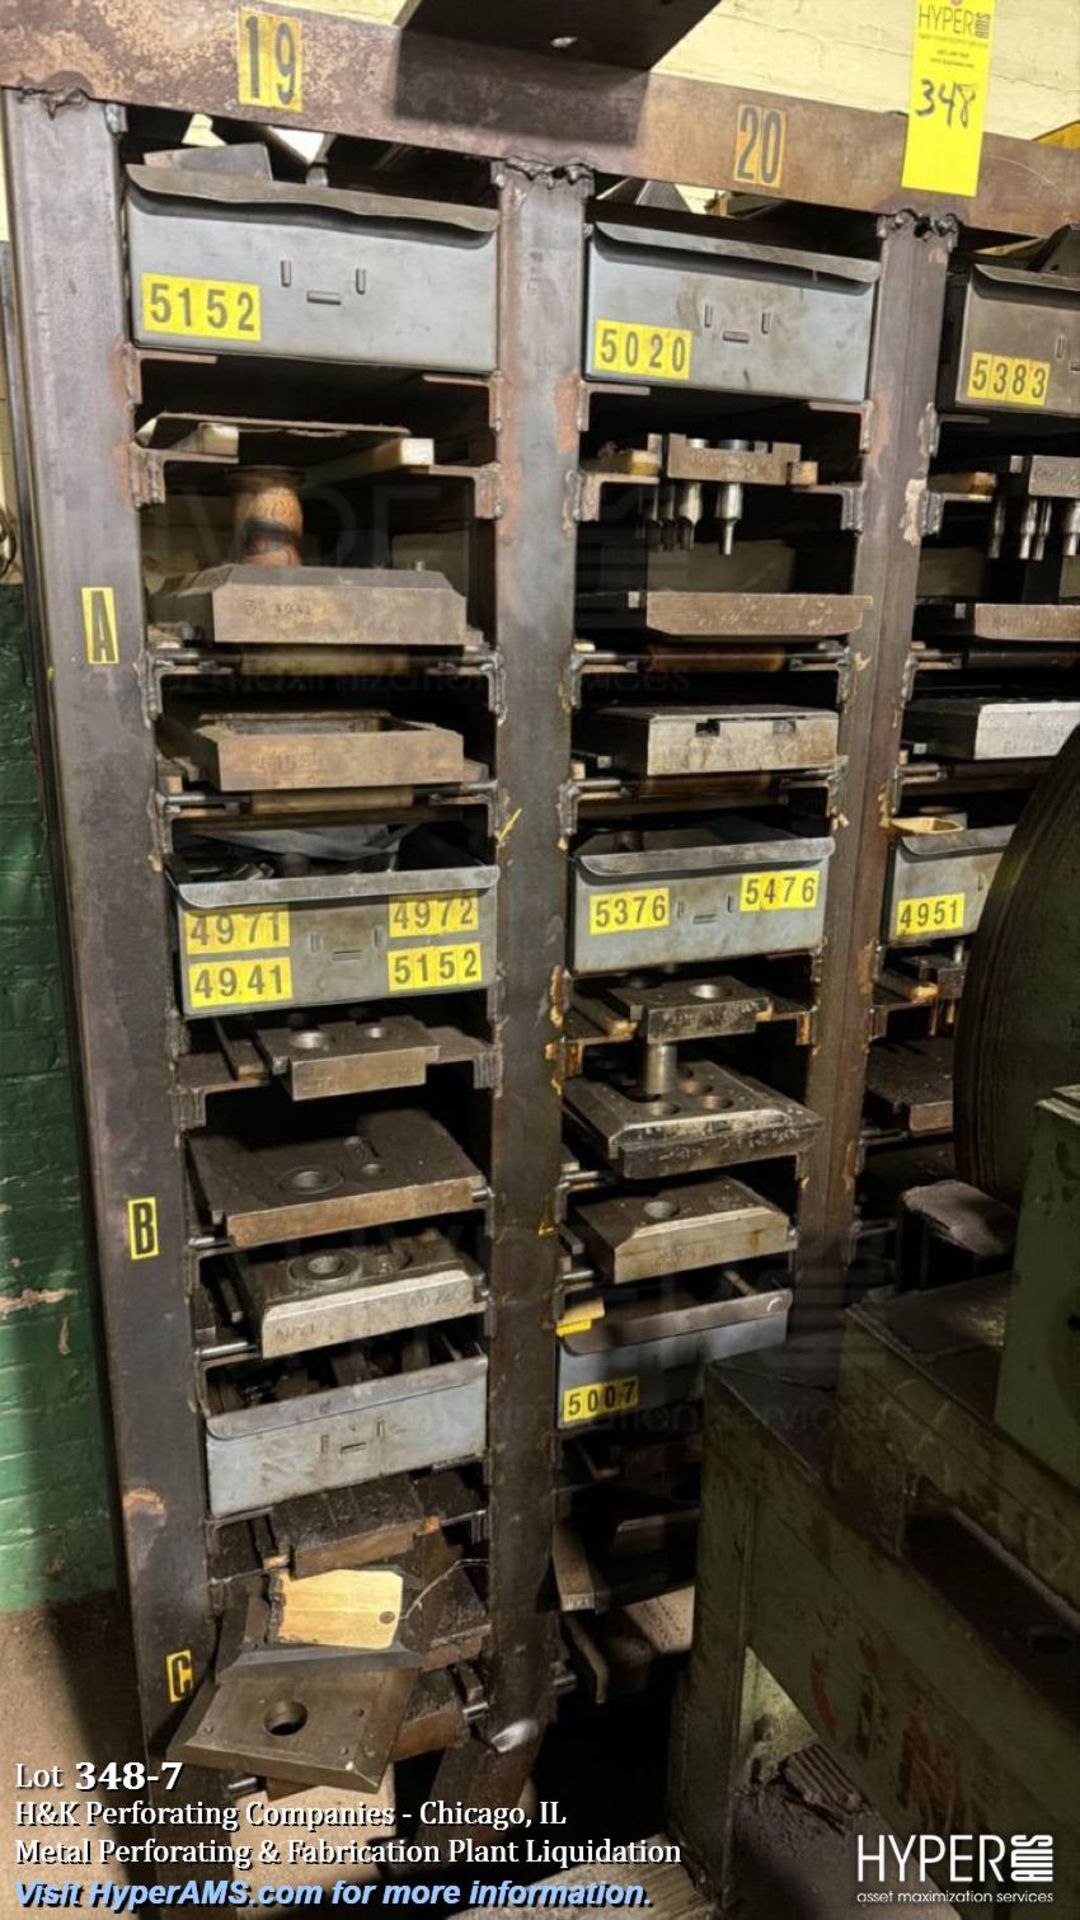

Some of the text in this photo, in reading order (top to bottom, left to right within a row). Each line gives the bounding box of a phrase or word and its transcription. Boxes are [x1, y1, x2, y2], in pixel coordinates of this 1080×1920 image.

[919, 4, 973, 34] HYPER
[245, 15, 297, 104] 19
[915, 79, 977, 128] 348
[737, 109, 785, 184] 20
[150, 284, 256, 332] 5152
[600, 328, 686, 371] 5020
[971, 353, 1047, 400] 5383
[89, 589, 117, 663] A
[745, 876, 818, 904] 5476
[190, 909, 281, 946] 4971
[394, 900, 475, 929] 4972
[595, 895, 667, 928] 5376
[899, 899, 960, 929] 4951
[195, 964, 283, 999] 4941
[395, 949, 478, 984] 5152
[133, 1201, 155, 1256] B
[568, 1381, 636, 1416] 5007
[171, 1655, 192, 1697] C
